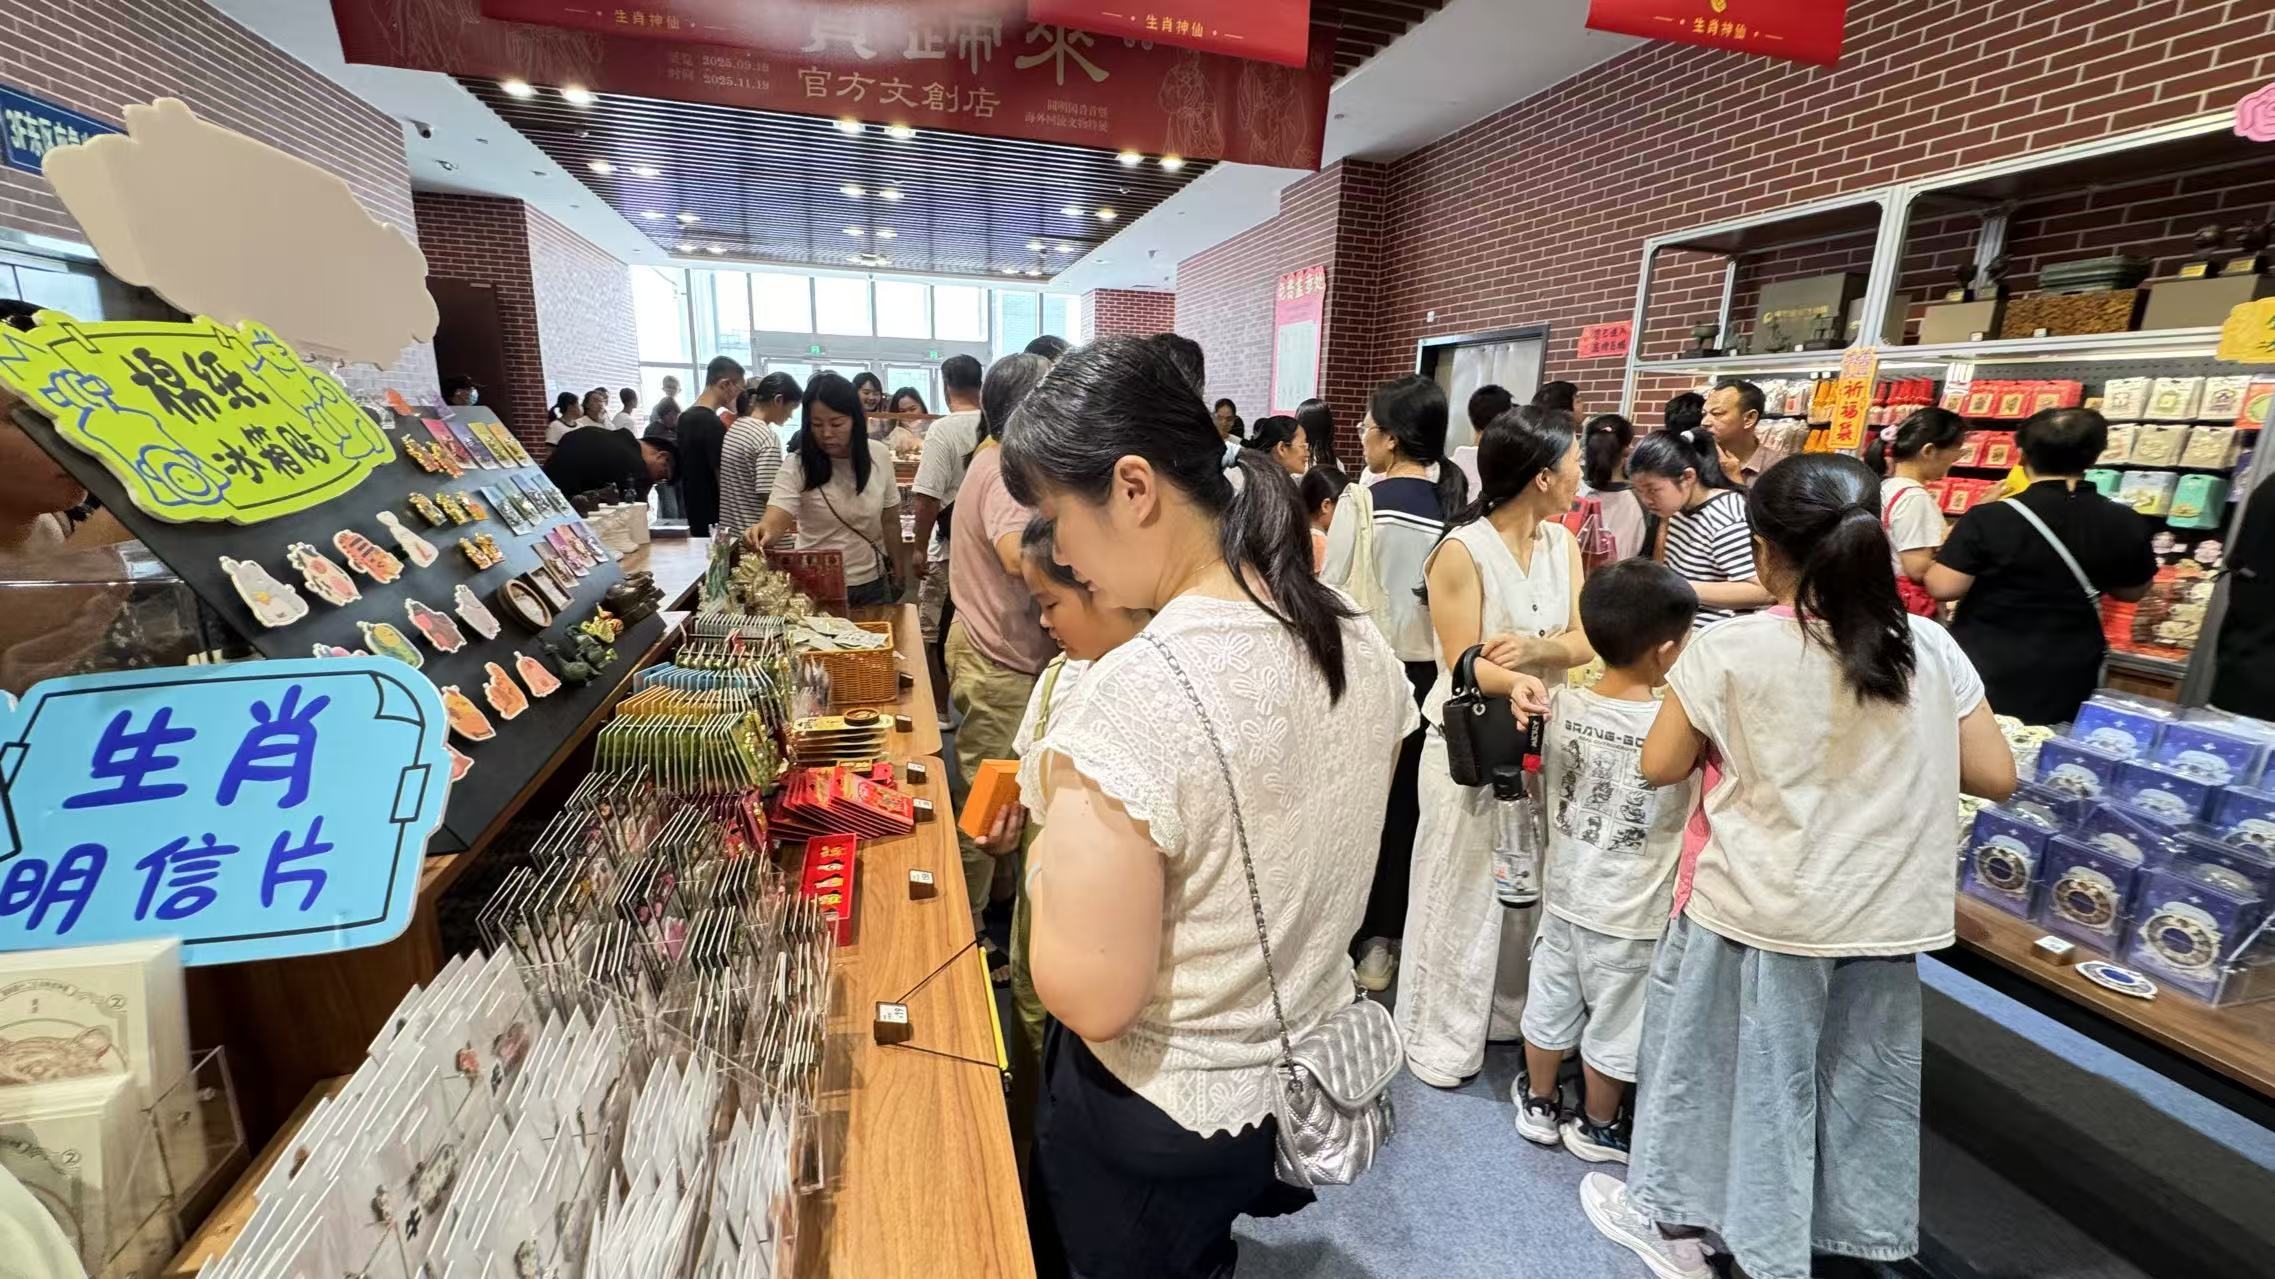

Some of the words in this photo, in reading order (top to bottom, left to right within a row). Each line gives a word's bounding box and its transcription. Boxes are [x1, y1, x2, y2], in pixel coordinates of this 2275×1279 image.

[614, 10, 681, 29] 生肖神仙
[1145, 14, 1204, 38] 生肖神仙
[1693, 18, 1746, 39] 生肖神仙
[798, 66, 1001, 118] 官方文創店
[1837, 380, 1864, 441] 祈福袋
[211, 421, 330, 484] 冰箱贴
[62, 684, 331, 809] 生肖
[0, 815, 335, 935] 明信片
